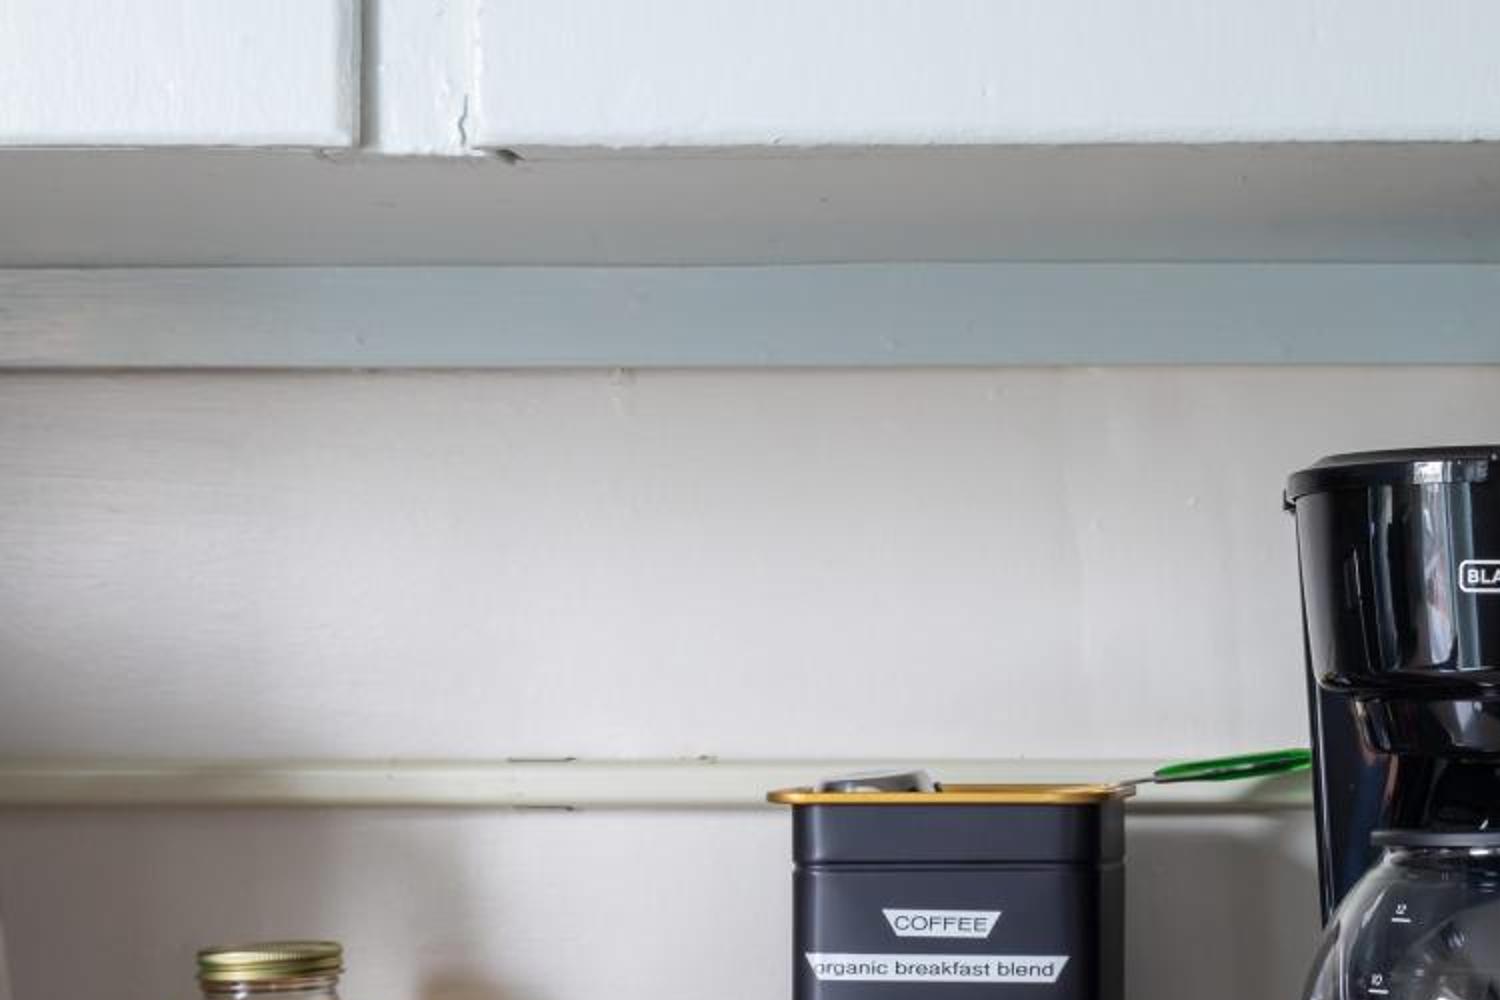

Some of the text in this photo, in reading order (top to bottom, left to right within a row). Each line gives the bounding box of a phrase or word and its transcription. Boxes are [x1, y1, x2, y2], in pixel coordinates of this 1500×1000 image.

[895, 915, 988, 932] COFFEE
[895, 961, 990, 976] breakfast
[997, 961, 1054, 976] blend
